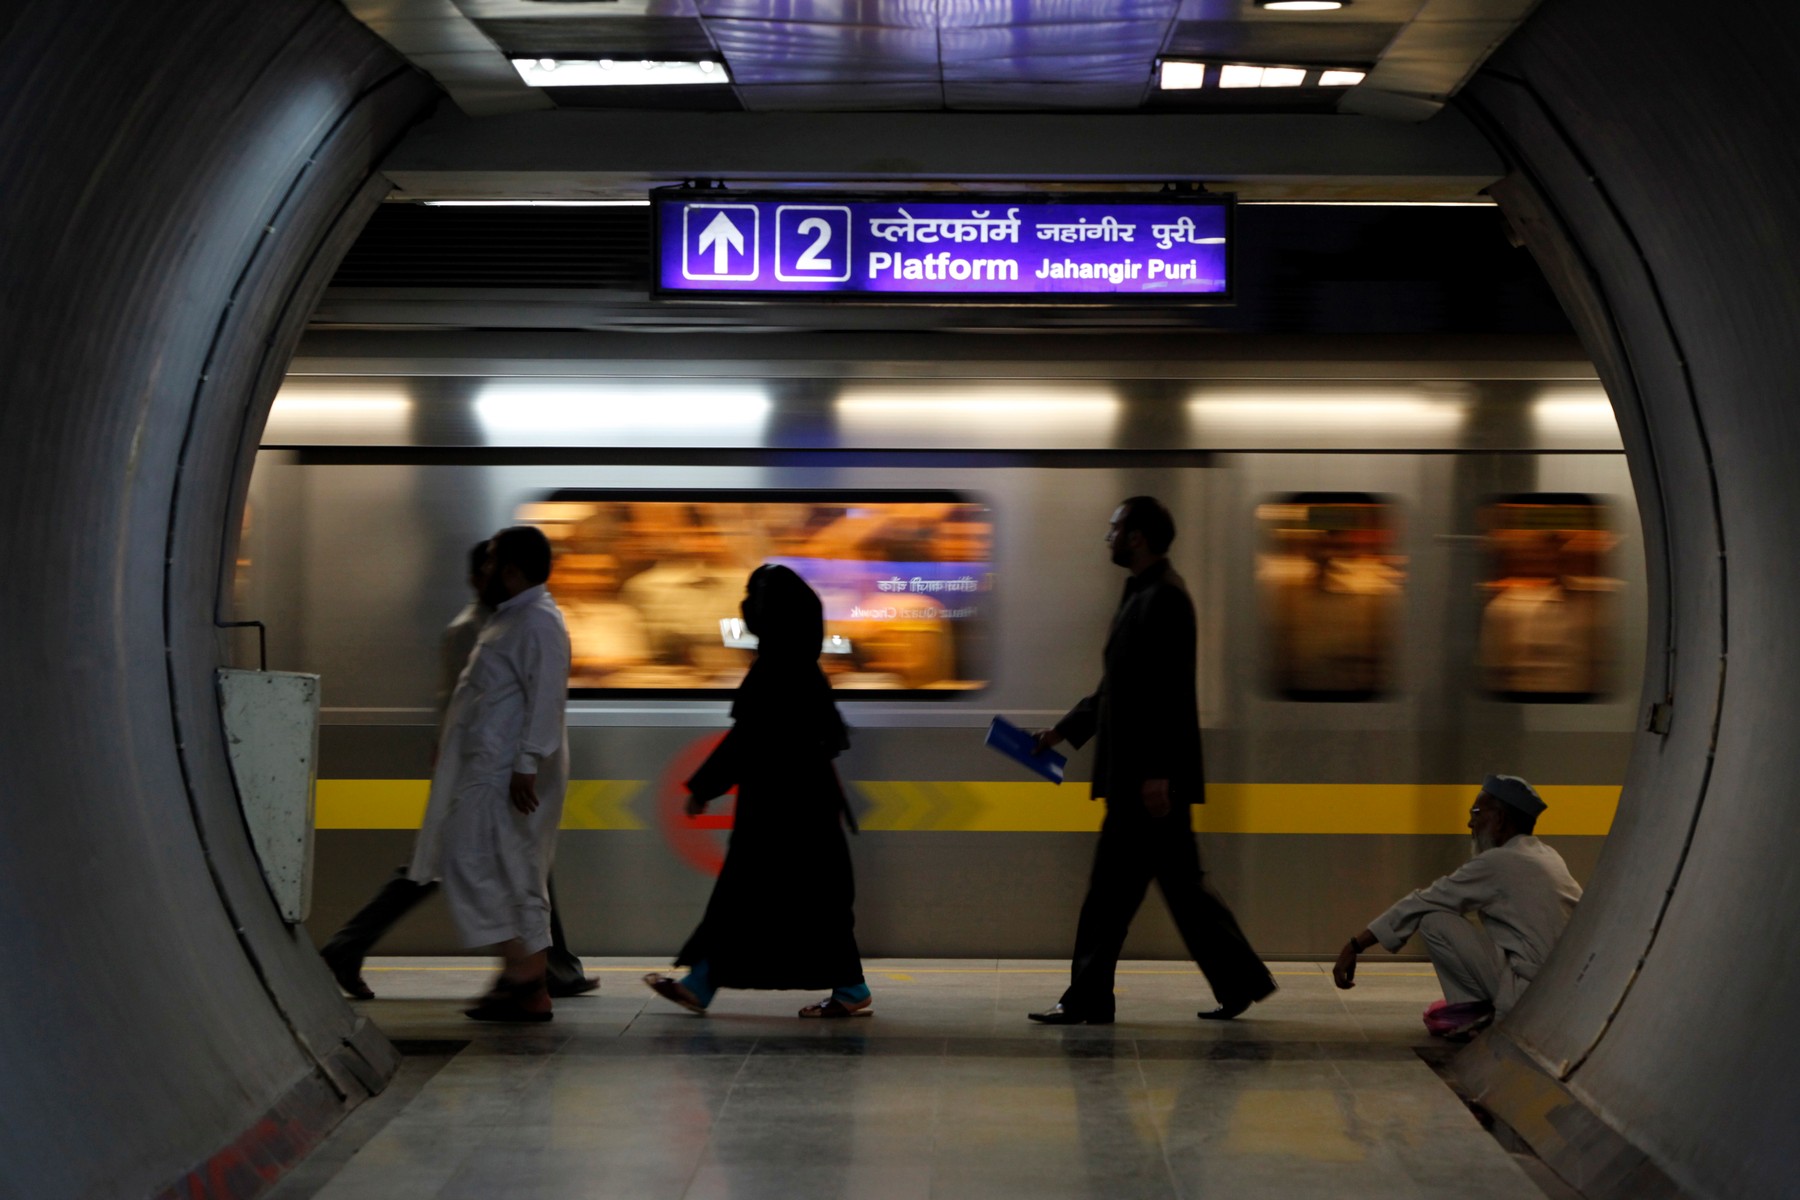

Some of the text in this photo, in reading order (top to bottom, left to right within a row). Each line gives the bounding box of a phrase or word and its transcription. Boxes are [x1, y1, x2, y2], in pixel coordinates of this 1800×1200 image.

[795, 216, 833, 270] 2
[869, 207, 1196, 249] प्लेटफॉर्म जहांगीर पुरी
[868, 252, 1198, 284] Platform Jahangir Puri
